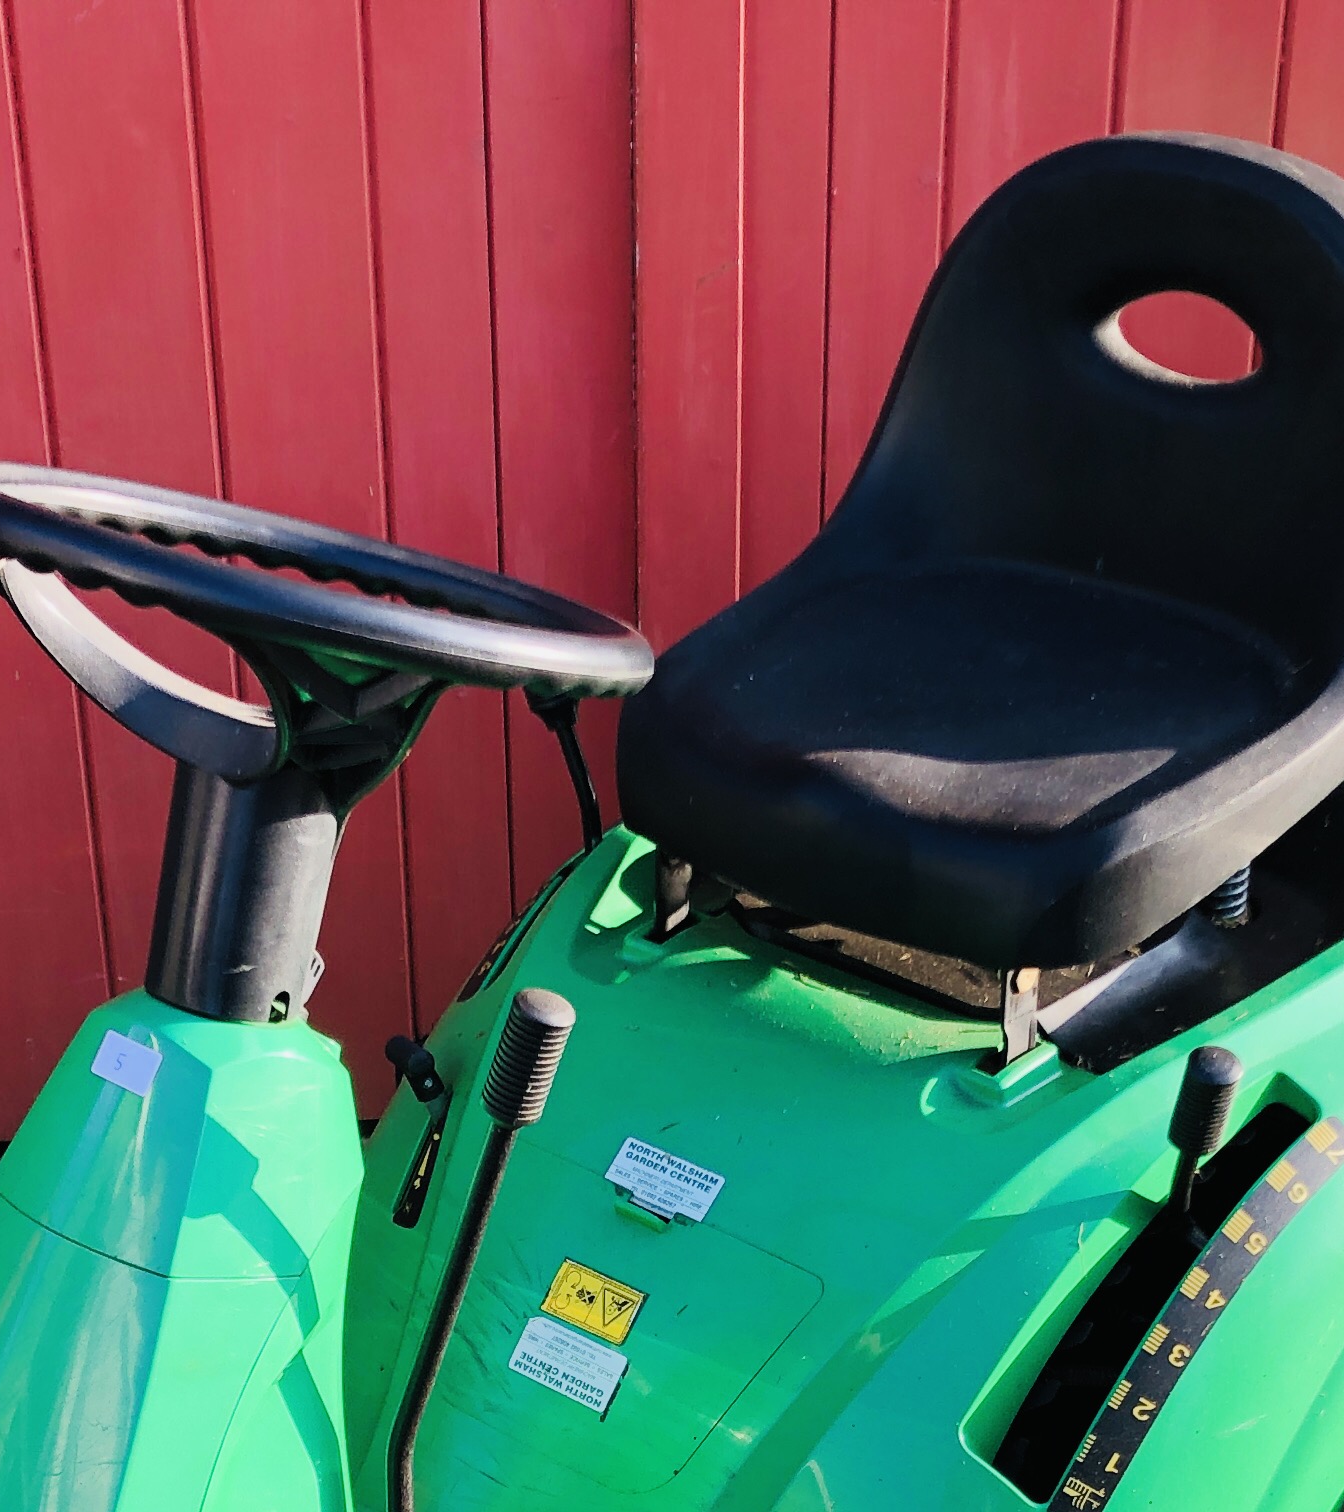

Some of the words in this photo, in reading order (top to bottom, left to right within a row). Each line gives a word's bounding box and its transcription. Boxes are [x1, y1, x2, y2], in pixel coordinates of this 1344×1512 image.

[113, 1052, 128, 1071] 5
[624, 1150, 669, 1174] GARDEN
[668, 1169, 712, 1194] CENTRE
[627, 1141, 665, 1162] NORTH
[666, 1157, 719, 1186] WALSHAM
[636, 1177, 658, 1190] SERVICE
[662, 1189, 684, 1202] SPARES
[1287, 1181, 1309, 1204] 6
[1244, 1232, 1268, 1256] 5
[1204, 1288, 1226, 1310] 4
[518, 1350, 560, 1376] CENTRE
[1167, 1344, 1191, 1368] 3
[512, 1358, 563, 1389] WALSHAM
[560, 1371, 605, 1398] GARDEN
[563, 1384, 602, 1407] NORTH
[1131, 1396, 1157, 1422] 2
[1104, 1451, 1120, 1474] 1
